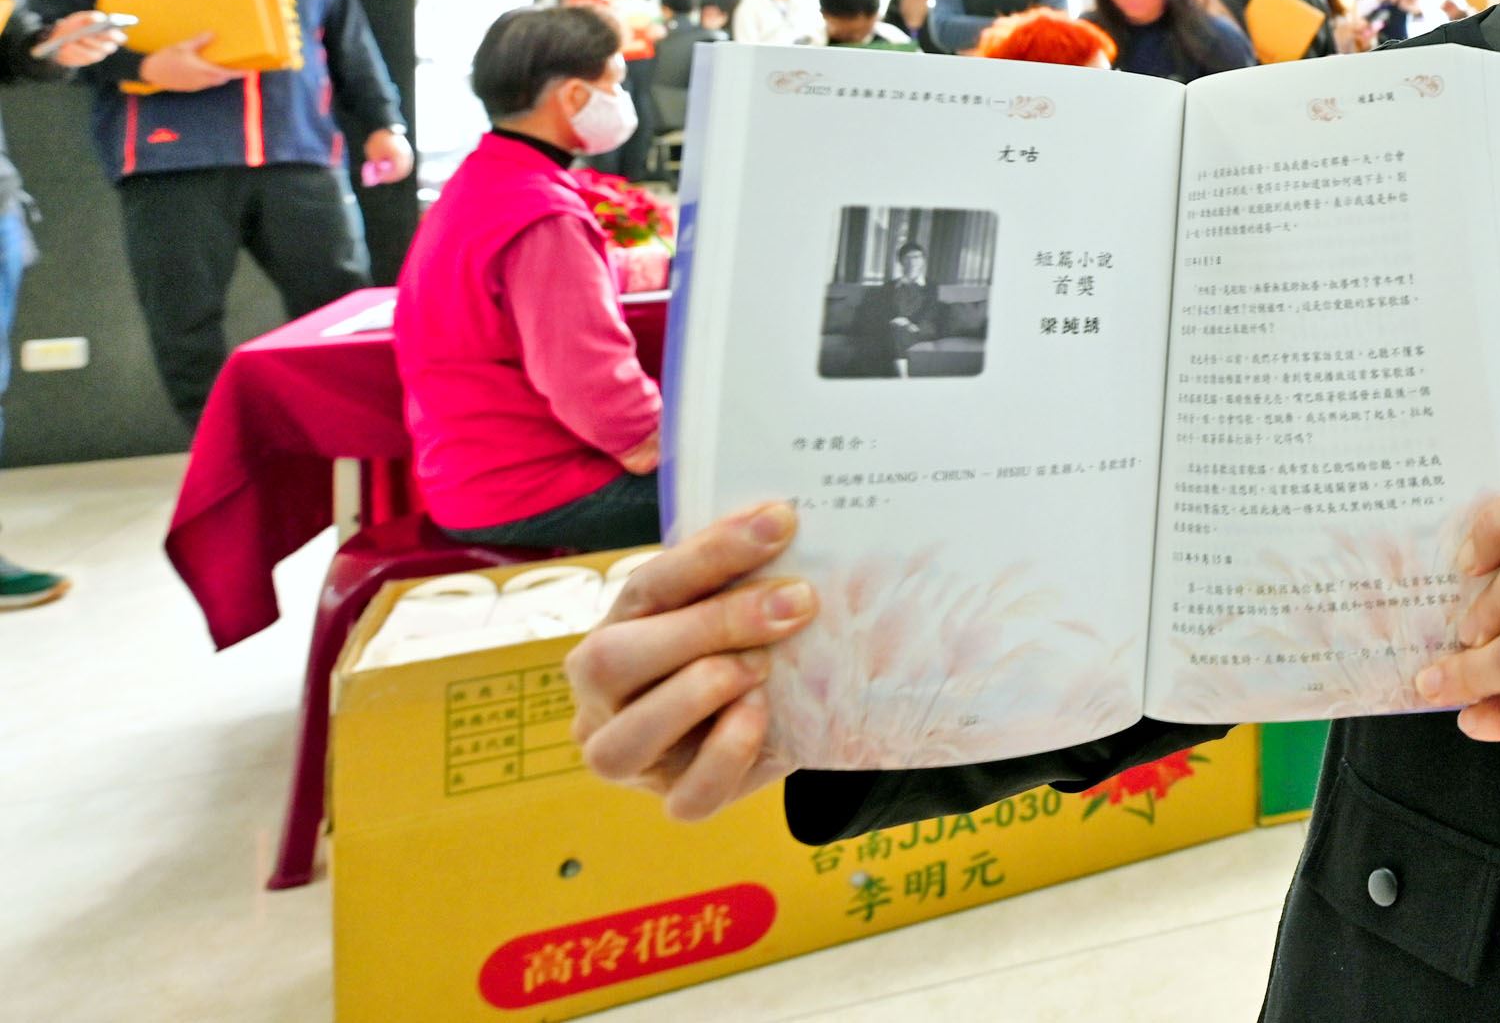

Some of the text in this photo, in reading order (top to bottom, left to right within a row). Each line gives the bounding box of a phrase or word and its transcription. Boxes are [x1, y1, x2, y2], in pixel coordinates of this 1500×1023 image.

[1033, 249, 1114, 270] 短篇小說
[1052, 274, 1096, 297] 首獎
[845, 850, 1007, 923] 李明元
[521, 902, 733, 994] 高冷花卉
